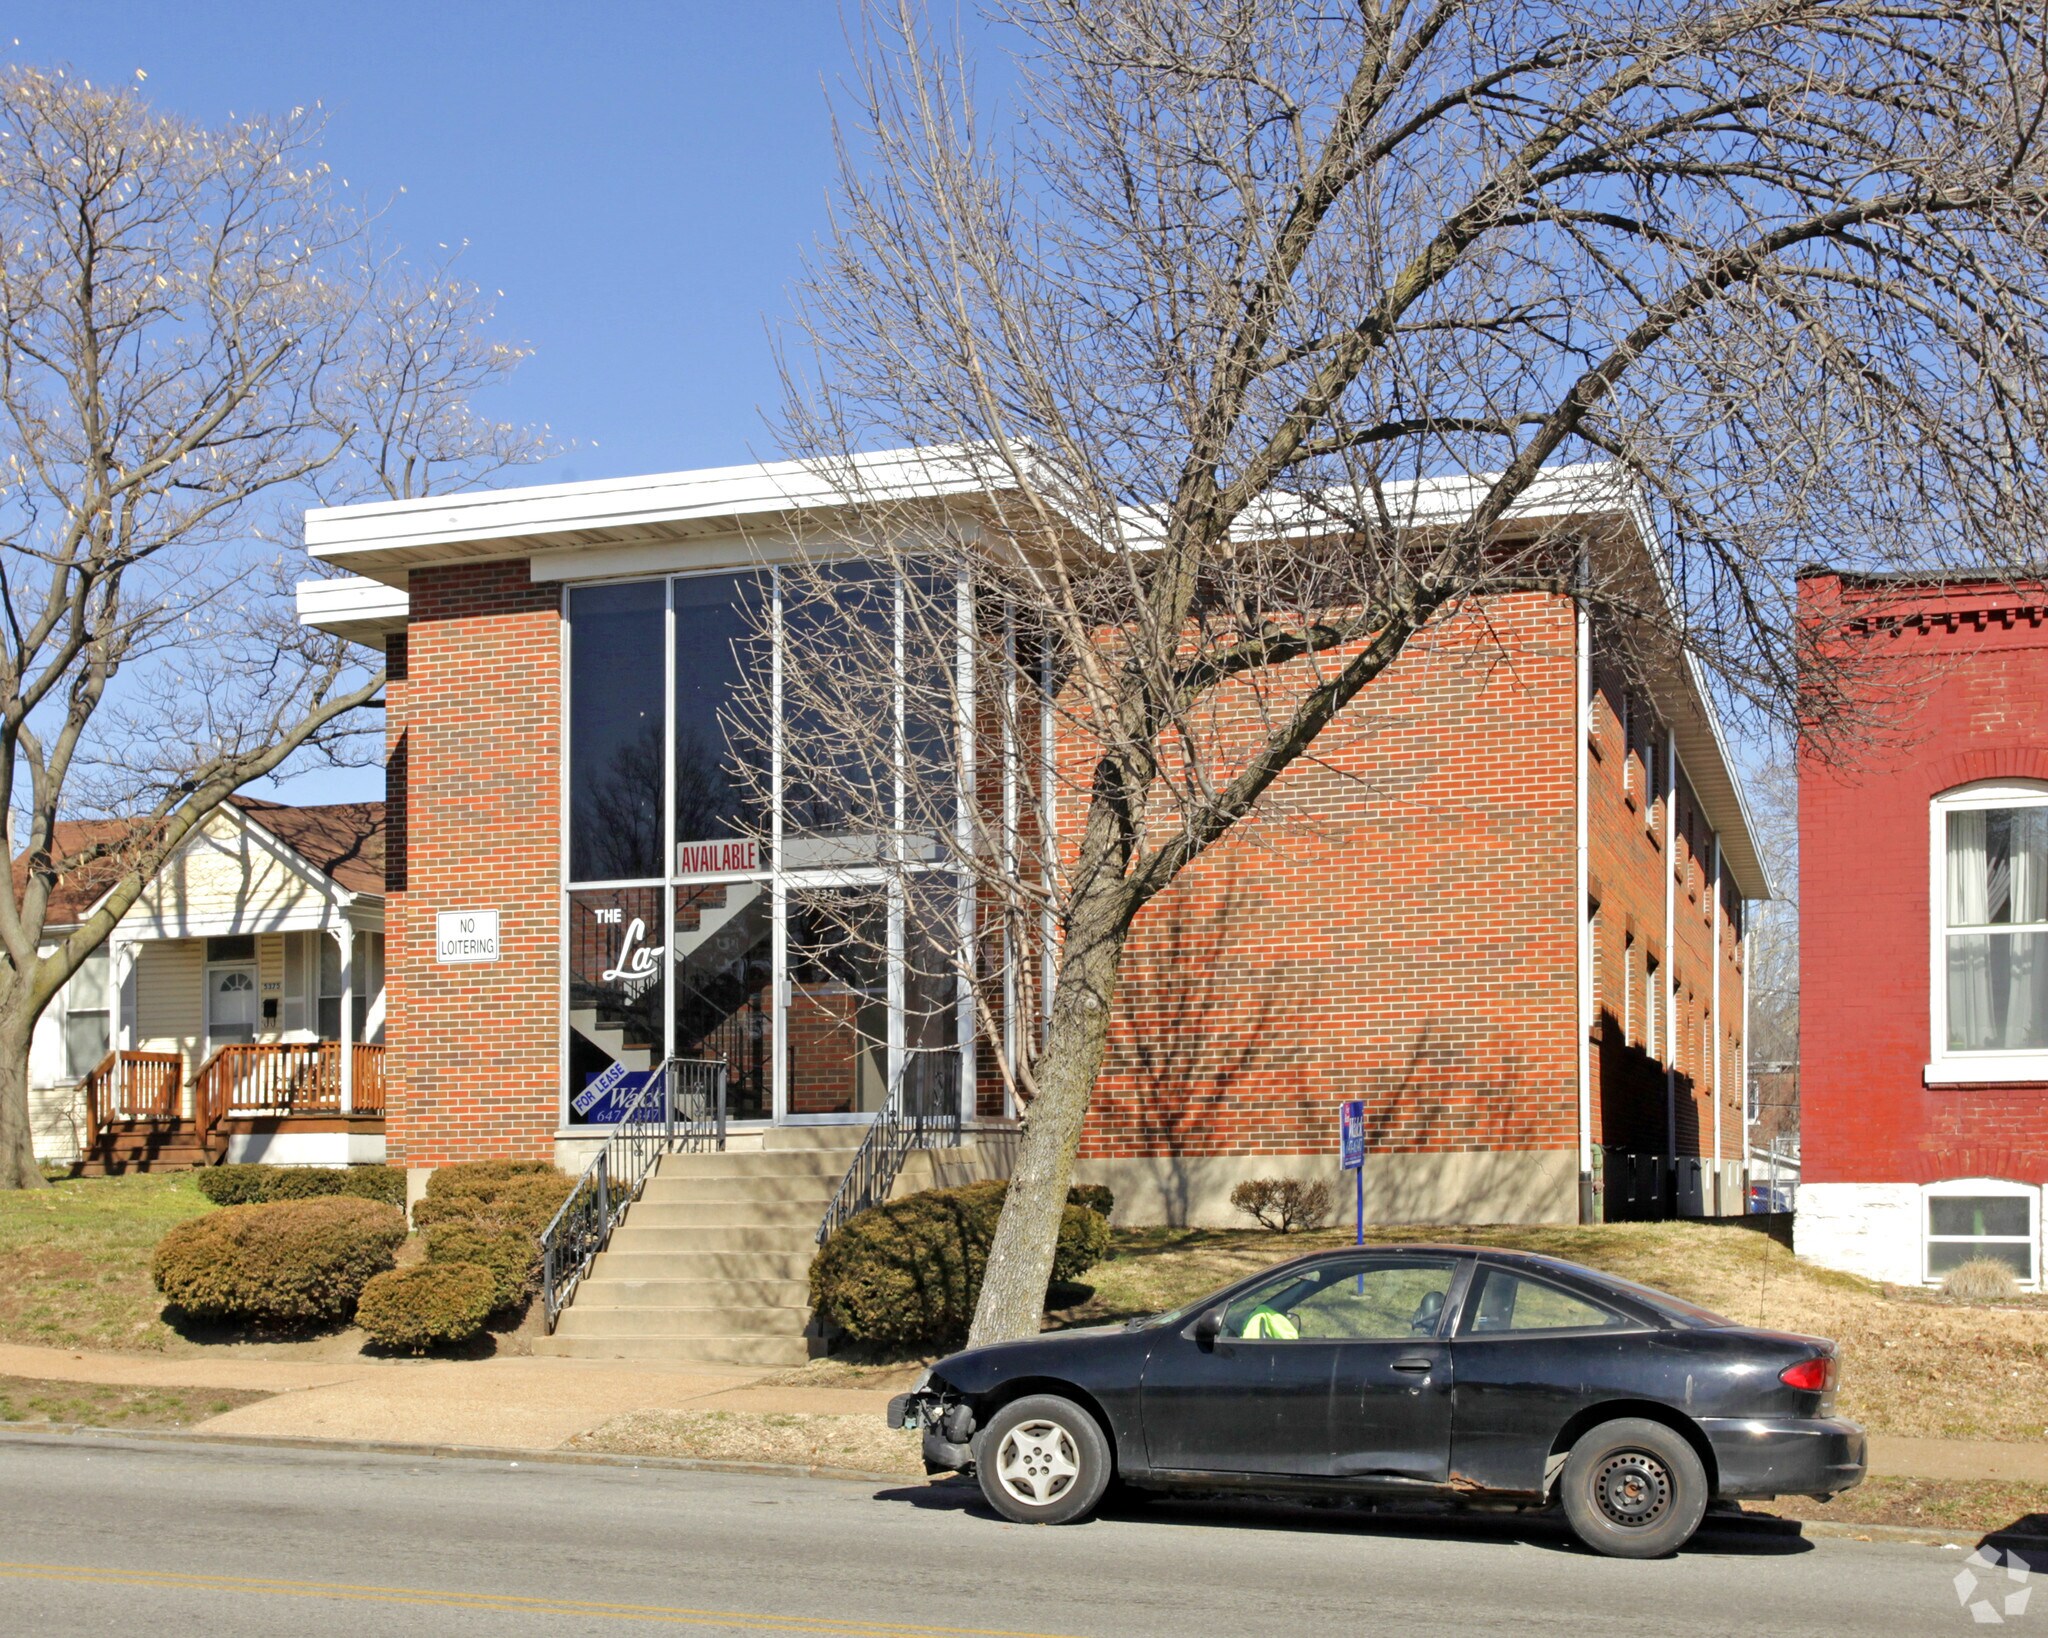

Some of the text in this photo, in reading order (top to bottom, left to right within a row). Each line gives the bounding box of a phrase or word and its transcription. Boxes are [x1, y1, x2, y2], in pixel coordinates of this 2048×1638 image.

[682, 842, 756, 873] AVAILABLE
[460, 918, 475, 933] NO
[594, 908, 622, 924] THE
[441, 938, 494, 955] LOITERING
[575, 1063, 625, 1111] FOR LEASE
[609, 1086, 666, 1109] Wack
